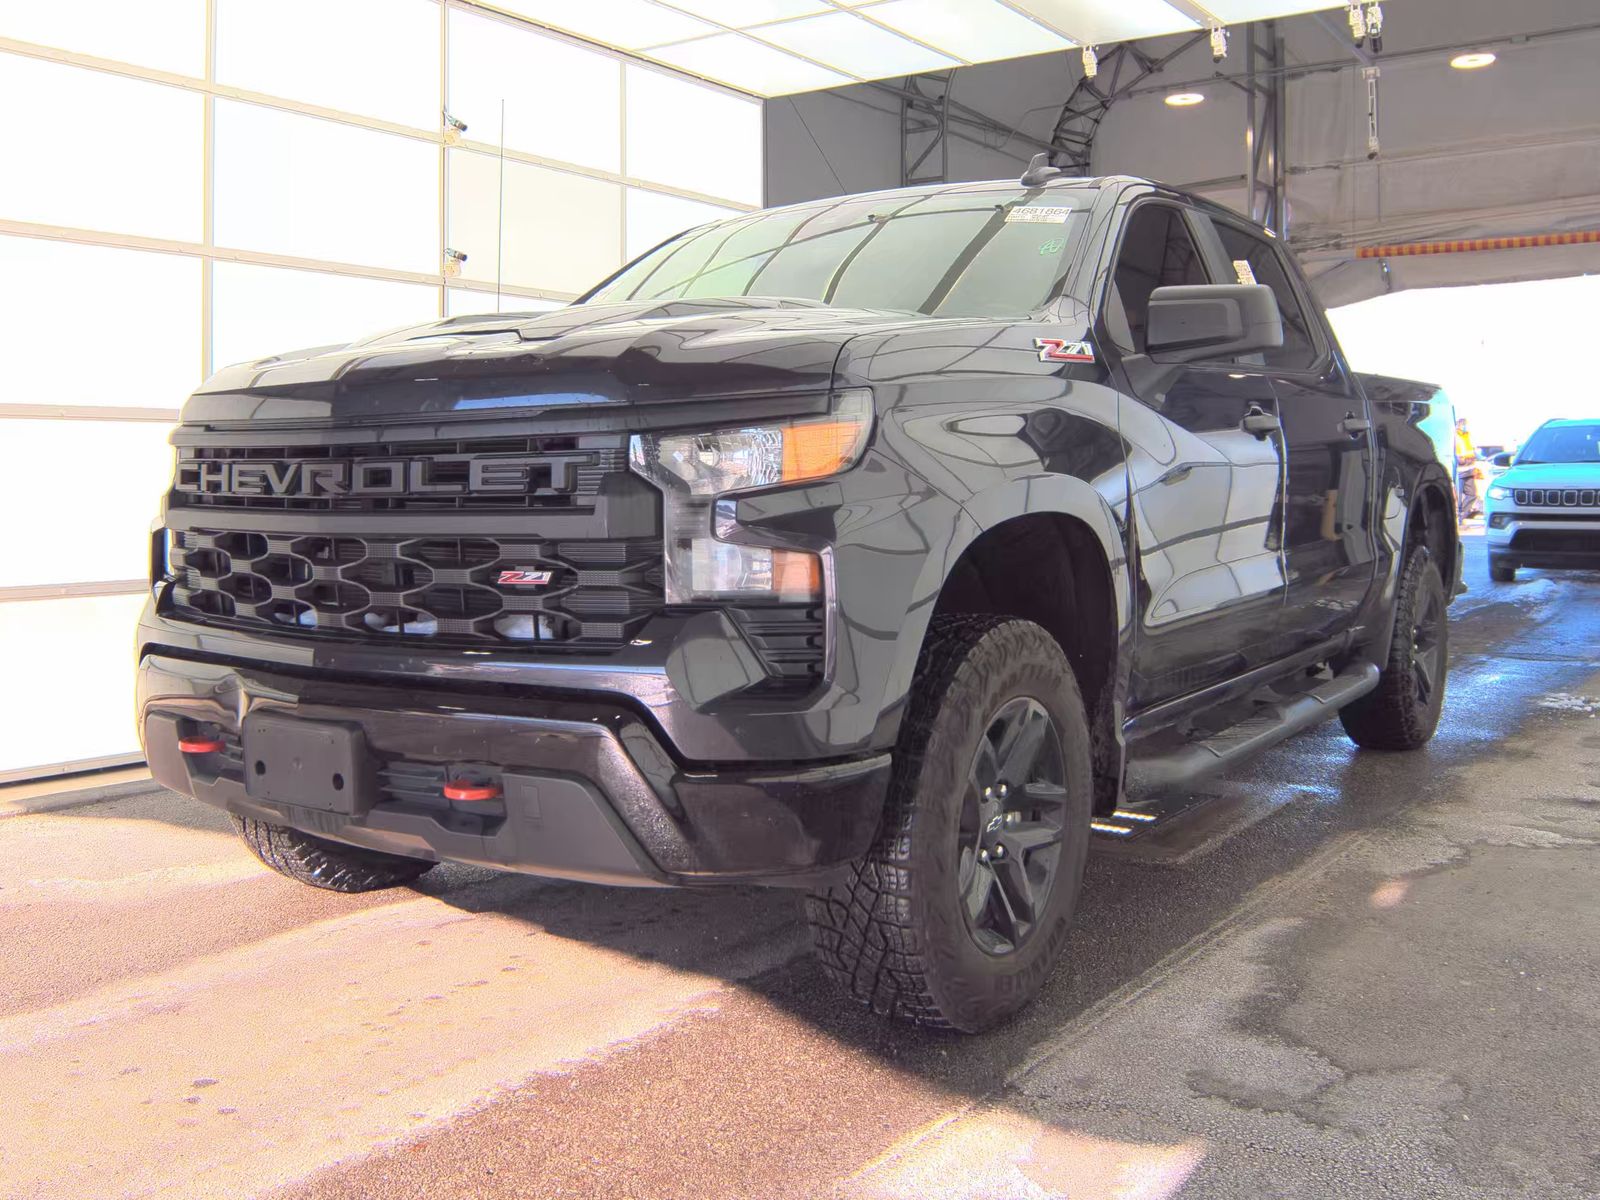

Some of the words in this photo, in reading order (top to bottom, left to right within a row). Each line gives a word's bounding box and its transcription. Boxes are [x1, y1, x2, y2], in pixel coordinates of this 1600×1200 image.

[1033, 337, 1094, 363] Z71
[175, 452, 598, 496] CHEVROLET
[497, 570, 552, 585] Z71
